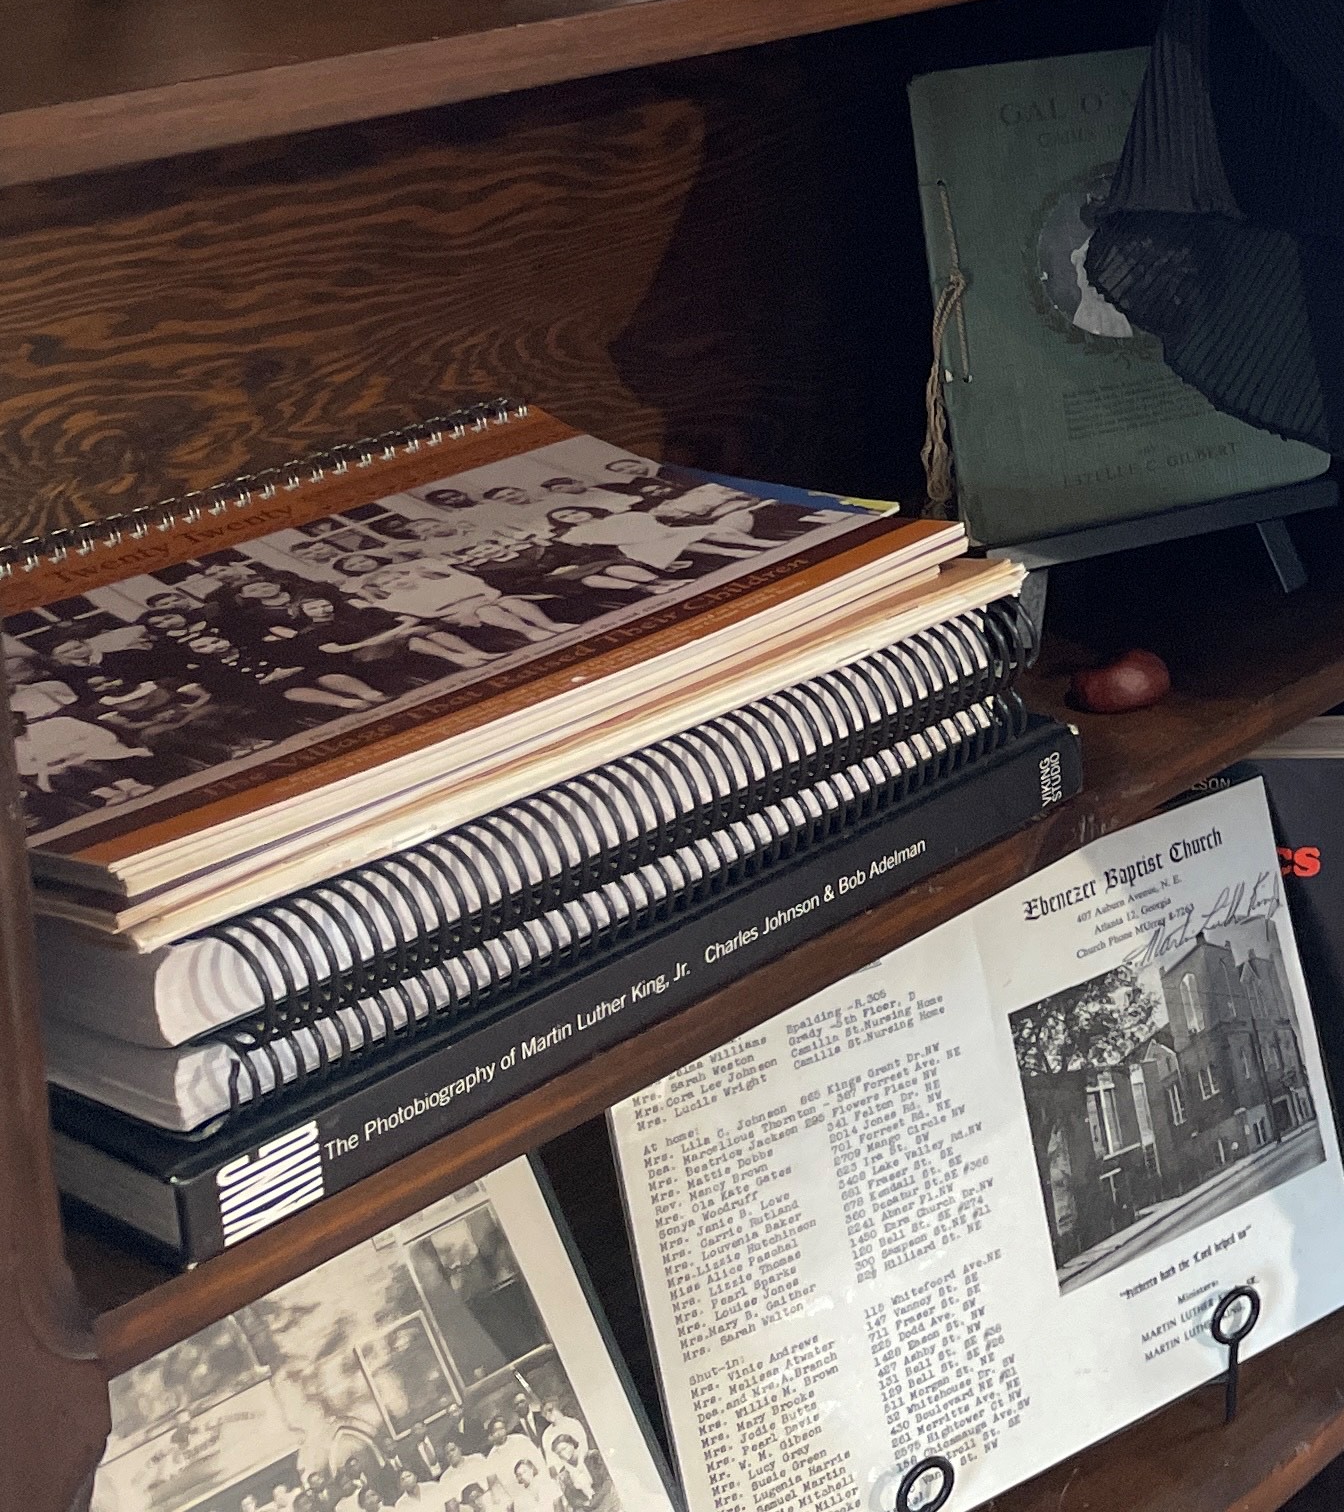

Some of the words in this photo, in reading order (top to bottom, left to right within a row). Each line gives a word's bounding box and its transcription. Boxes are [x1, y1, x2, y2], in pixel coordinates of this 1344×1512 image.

[51, 543, 172, 585] Twenty
[180, 503, 294, 545] Twenty
[602, 610, 677, 645] Their
[683, 557, 809, 613] Children
[1039, 756, 1052, 807] VIKING
[1049, 751, 1063, 803] STUDIO
[1023, 879, 1097, 921] Ebenezer
[1103, 851, 1165, 894] Baptist
[1169, 826, 1224, 864] Church
[1077, 910, 1092, 923] 407
[1095, 899, 1125, 917] Auburn
[1095, 917, 1124, 935] Atlanta
[1076, 940, 1106, 959] Church
[1108, 930, 1133, 947] Phone
[324, 1132, 361, 1162] The
[364, 1060, 498, 1142] Photobiography
[500, 1046, 519, 1071] of
[520, 1023, 574, 1063] Martin
[576, 993, 627, 1032] Luther
[631, 973, 671, 1003] King,
[673, 961, 692, 983] Jr.
[704, 927, 759, 965] Charles
[762, 896, 821, 936] Johnson
[823, 884, 835, 902] &
[838, 869, 867, 895] Bob
[869, 839, 928, 880] Adelman
[916, 995, 944, 1010] Home
[723, 1073, 768, 1099] Wright
[884, 1076, 918, 1097] Place
[215, 1120, 325, 1248] KING
[1141, 1318, 1177, 1343] MARTIN
[1145, 1337, 1181, 1362] MARTIN
